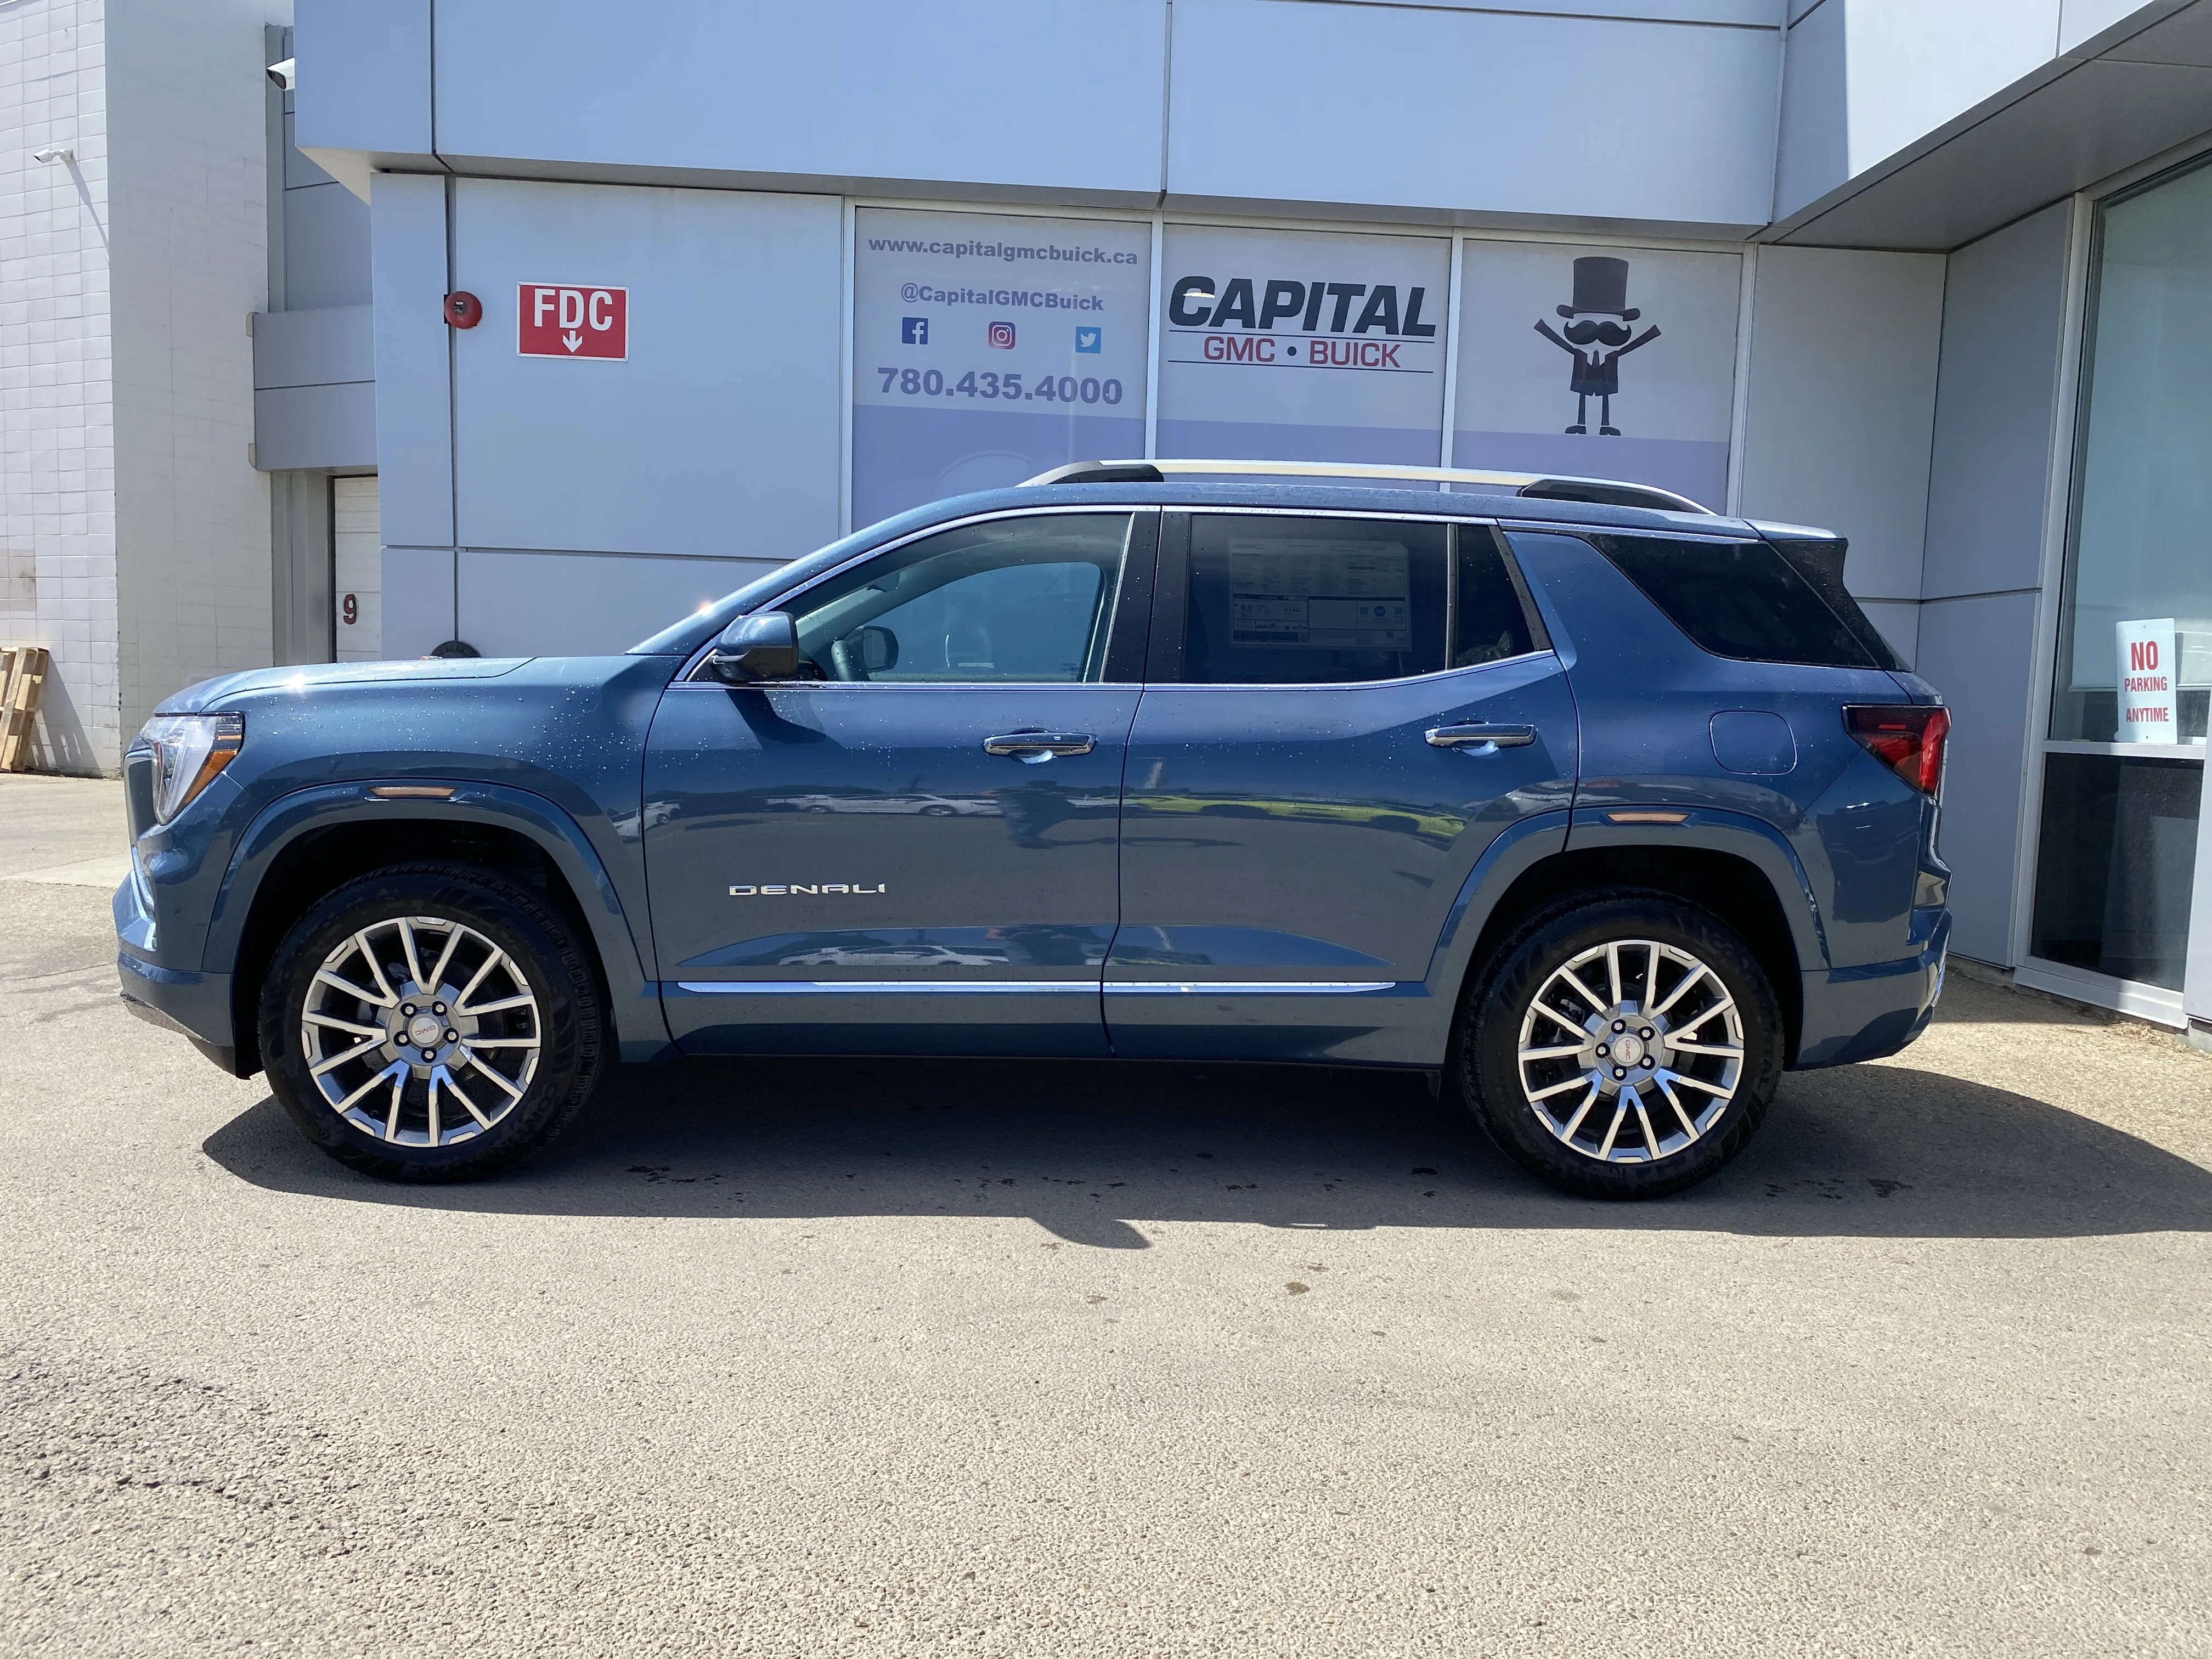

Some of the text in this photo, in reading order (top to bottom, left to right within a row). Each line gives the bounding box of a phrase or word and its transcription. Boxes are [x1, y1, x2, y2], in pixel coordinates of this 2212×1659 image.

[868, 239, 1137, 265] www.capitalgmcbuick.ca
[534, 288, 613, 331] FDC
[901, 282, 1104, 311] @CapitalGMCBuick
[1169, 276, 1436, 337] CAPITAL
[1204, 336, 1401, 368] GMC BUICK
[878, 367, 1122, 405] 780.435.4000
[343, 594, 357, 624] 9
[2131, 641, 2158, 671] NO
[2124, 676, 2167, 692] PARKING
[2126, 707, 2169, 722] ANYTIME
[729, 883, 885, 895] DENALI
[414, 1025, 436, 1036] GMC
